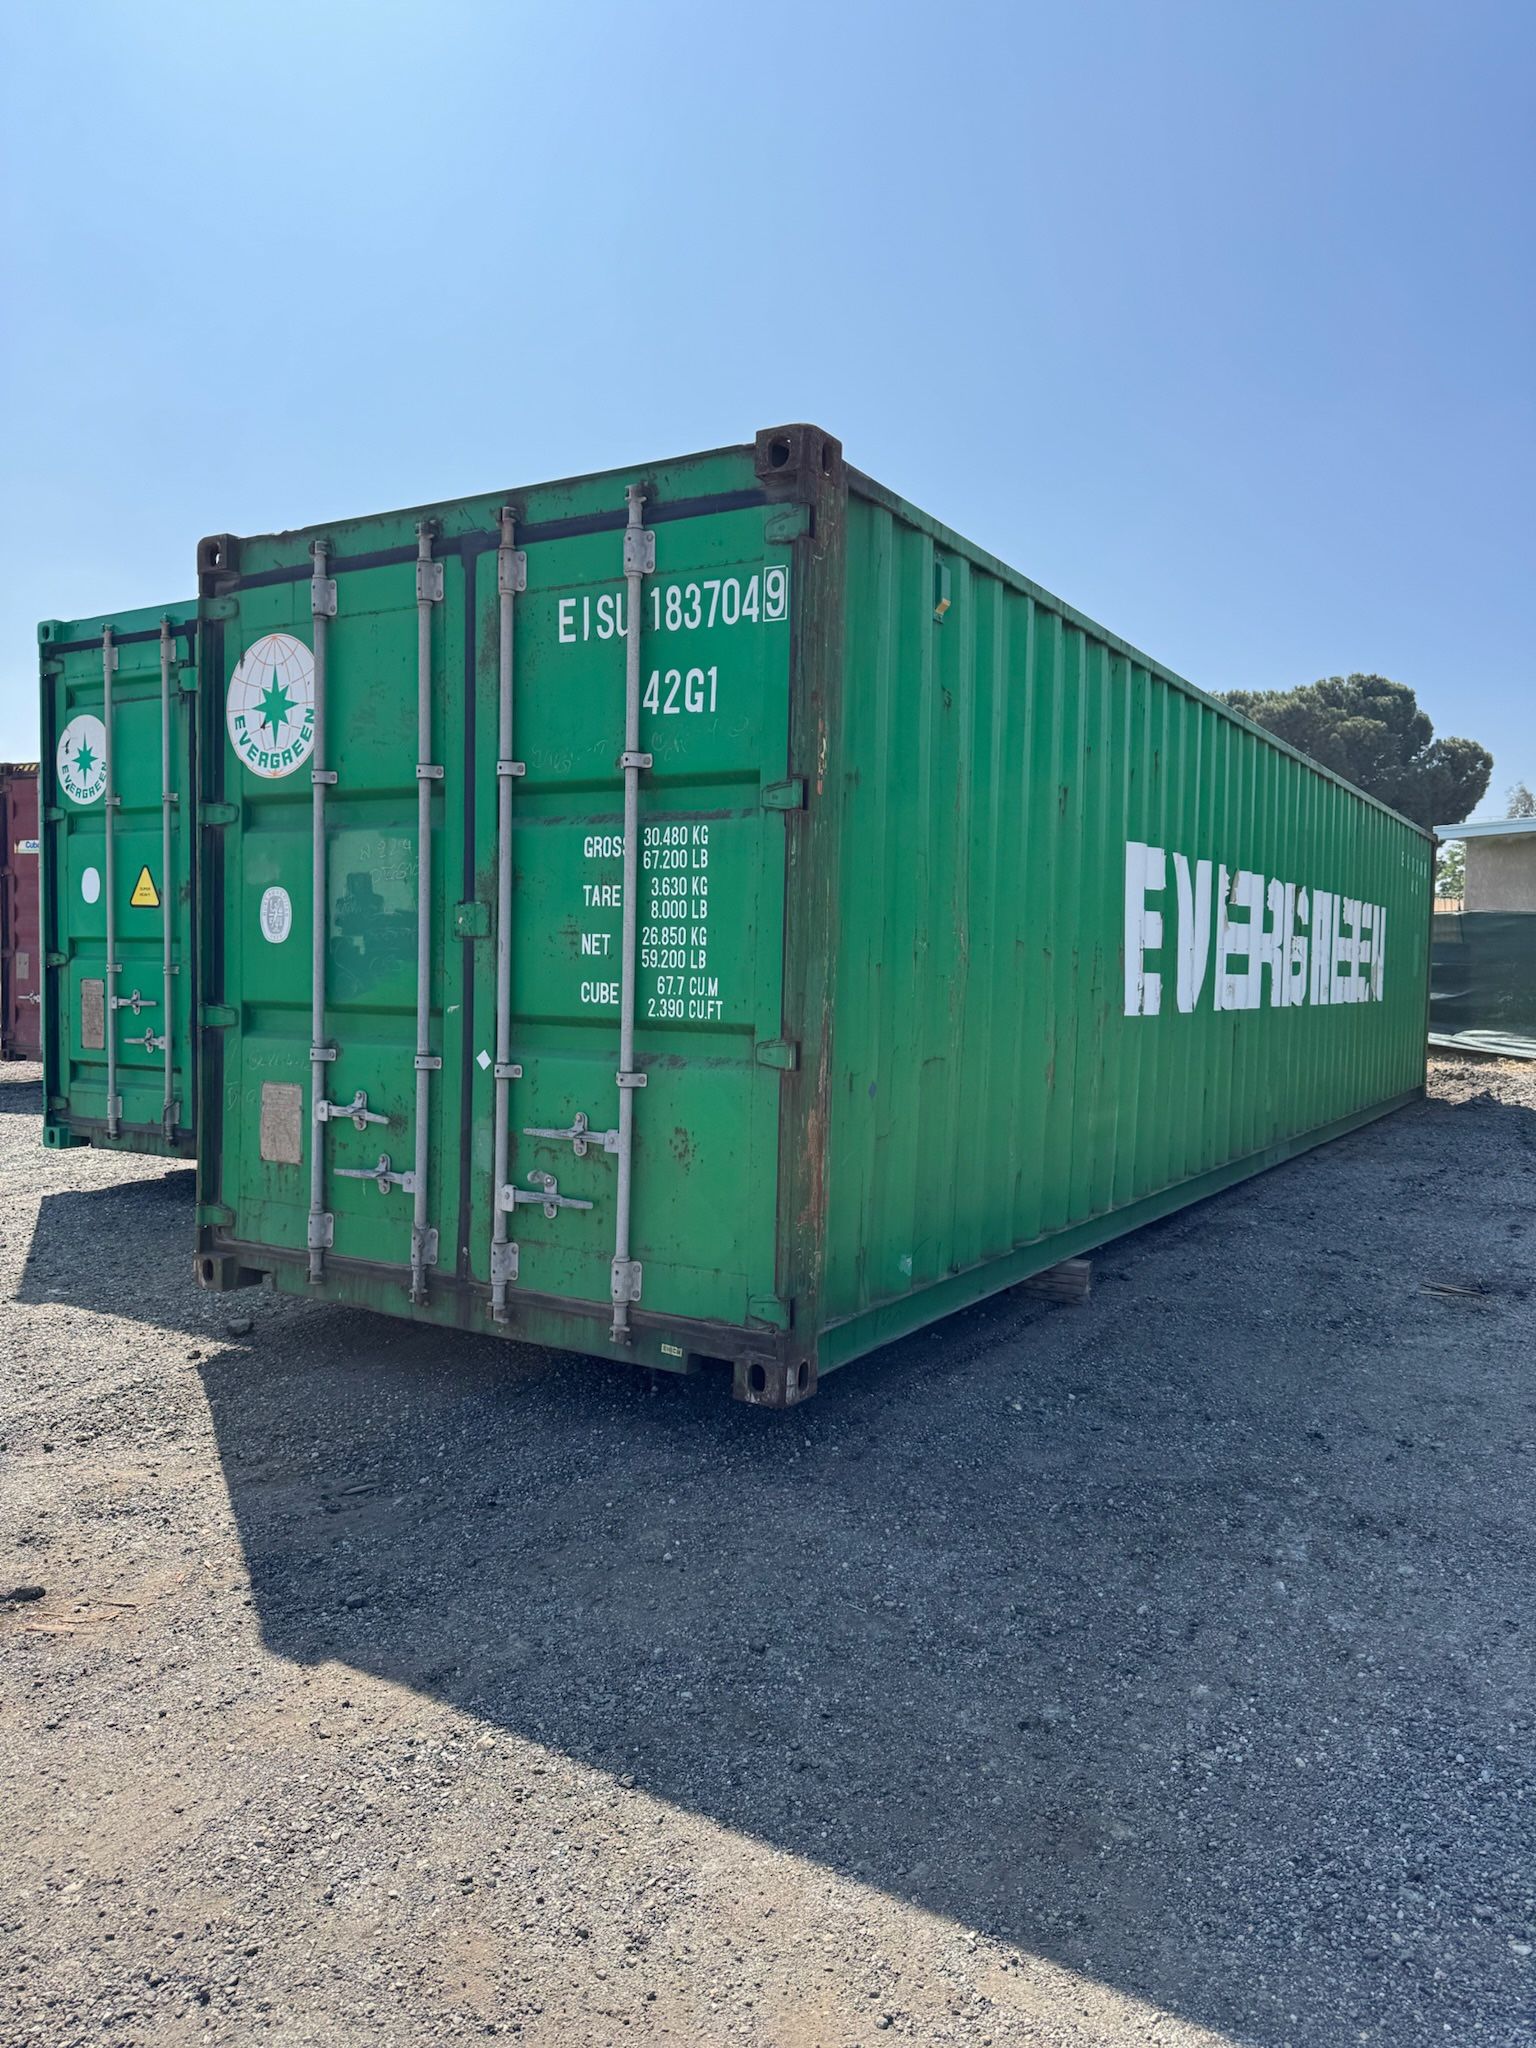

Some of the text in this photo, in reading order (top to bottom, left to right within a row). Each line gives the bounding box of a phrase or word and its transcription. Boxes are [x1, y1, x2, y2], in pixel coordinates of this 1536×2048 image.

[642, 666, 718, 715] 42G1
[234, 708, 314, 769] EVERGREEN
[61, 761, 107, 799] EVERGREEN
[584, 835, 626, 858] GROS
[643, 825, 709, 847] 30.480 KG
[643, 848, 708, 869] 67.200 LB
[583, 885, 622, 907] TARE
[651, 876, 708, 896] 3.630 KG
[651, 899, 708, 919] 8.000 LB
[581, 933, 611, 955] NET
[642, 926, 707, 946] 26.850 KG
[641, 949, 706, 969] 59.200 LB
[581, 981, 619, 1004] CUBE
[657, 975, 718, 997] 67.7 CU.M
[648, 998, 723, 1020] 2.390 CU.FT
